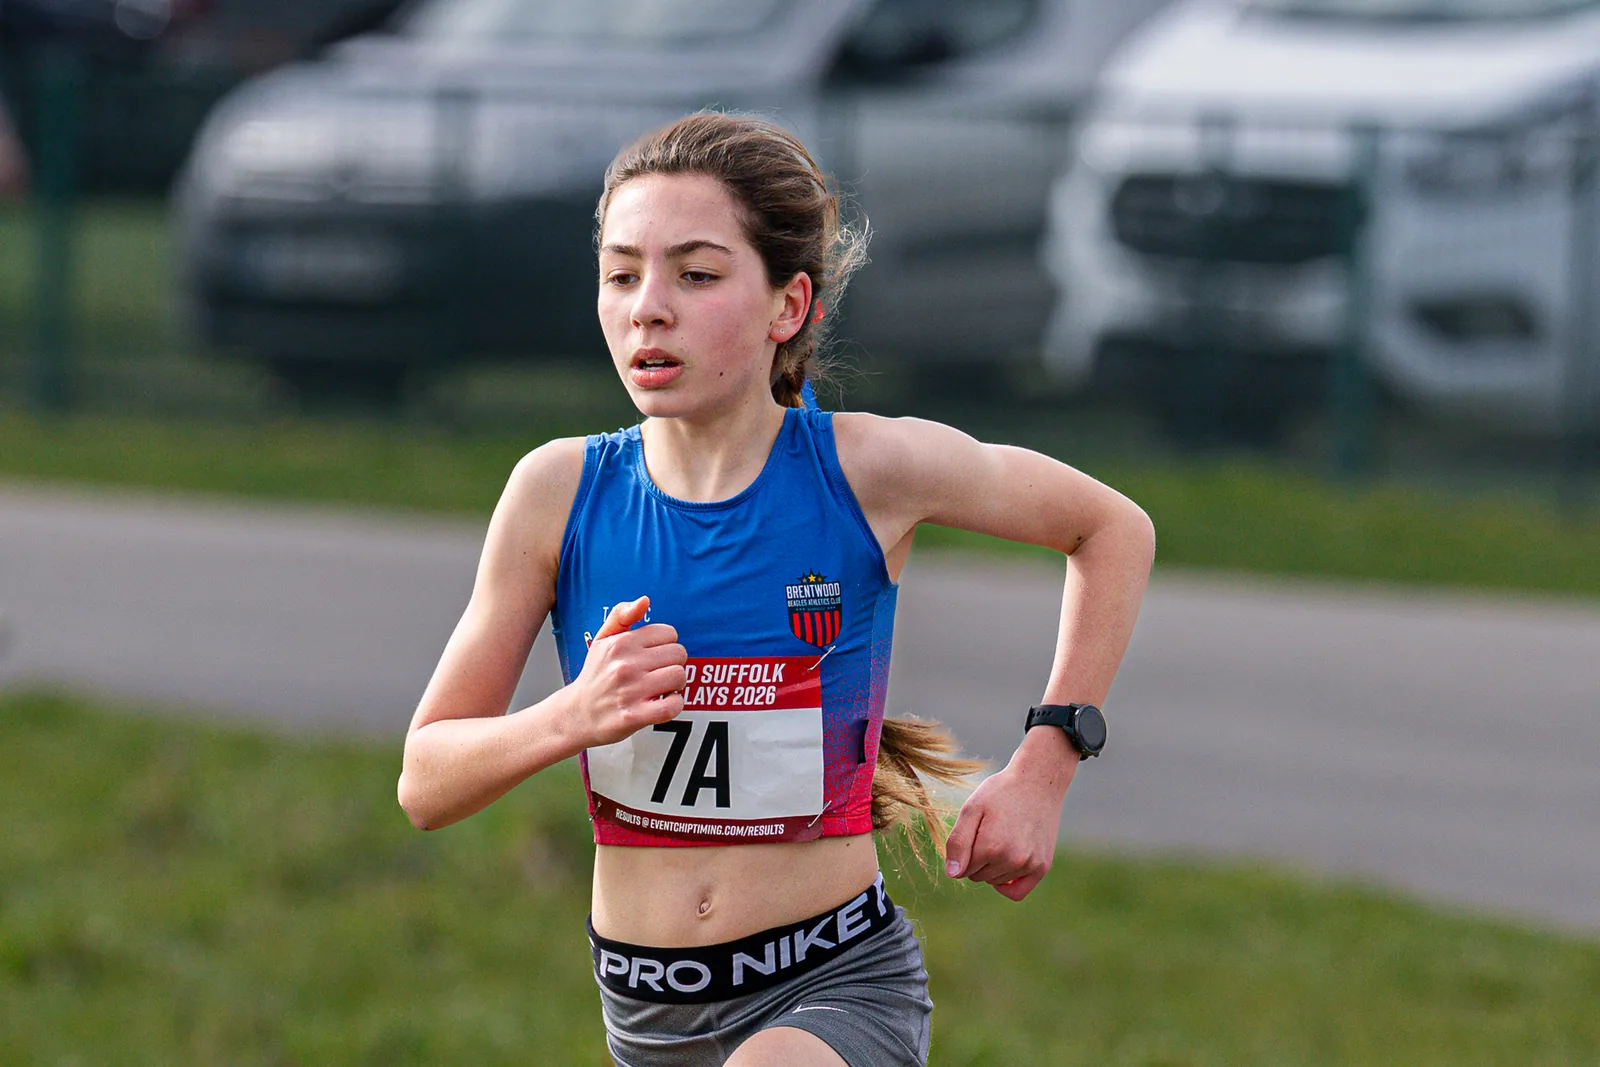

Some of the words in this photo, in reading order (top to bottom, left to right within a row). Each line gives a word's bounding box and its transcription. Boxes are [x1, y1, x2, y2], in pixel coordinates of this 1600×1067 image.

[786, 584, 840, 599] BRENTWOOD
[700, 663, 786, 684] SUFFOLK
[732, 686, 776, 706] 2026
[650, 719, 731, 809] 7A
[615, 809, 641, 827] RESULTS
[642, 818, 649, 828] @
[650, 818, 785, 837] EVENTCHIPTIMING.COM/RESULTS
[599, 949, 712, 992] PRO
[732, 893, 871, 986] NIKE
